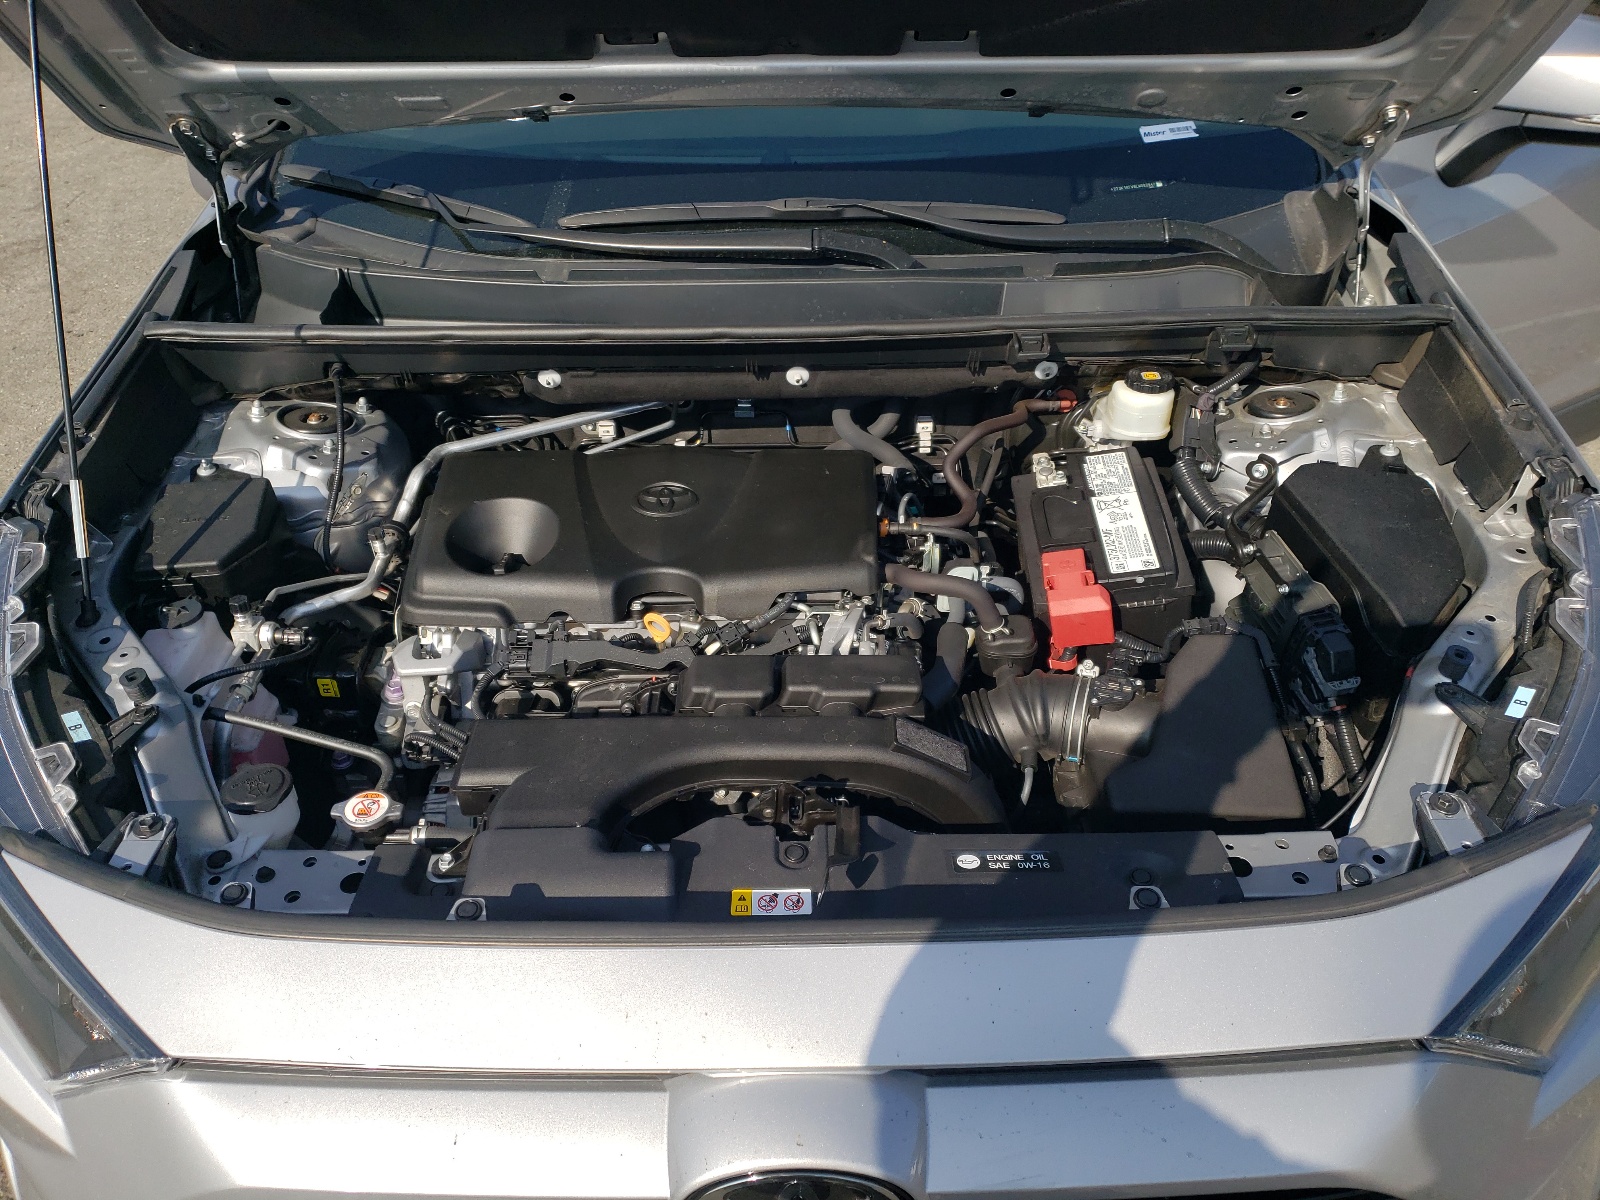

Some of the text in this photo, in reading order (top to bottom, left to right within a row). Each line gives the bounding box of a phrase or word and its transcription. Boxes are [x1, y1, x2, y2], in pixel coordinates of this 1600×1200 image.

[321, 683, 332, 694] R1
[68, 723, 82, 731] B
[1031, 853, 1048, 861] OIL
[1017, 861, 1051, 869] 0W-16
